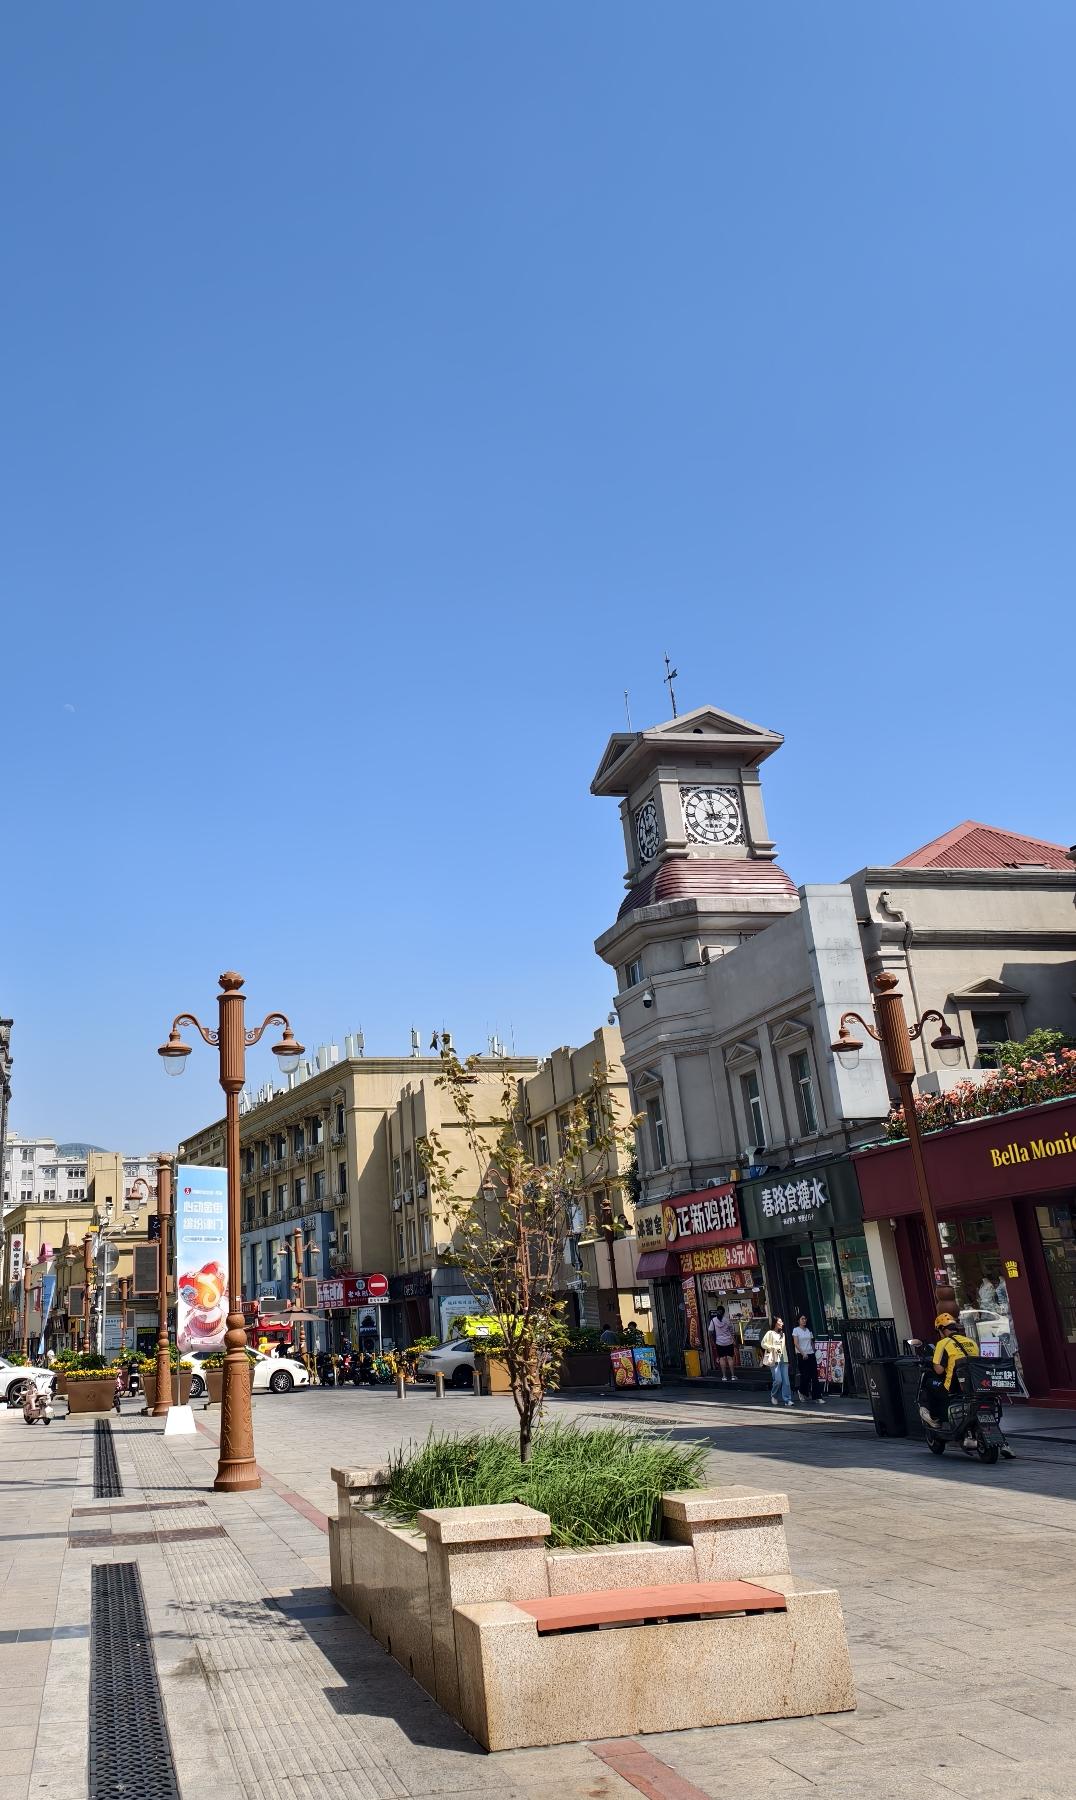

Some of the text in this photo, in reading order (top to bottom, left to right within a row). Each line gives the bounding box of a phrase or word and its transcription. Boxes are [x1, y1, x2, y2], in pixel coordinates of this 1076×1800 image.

[990, 1142, 1030, 1167] Bella
[676, 1194, 737, 1237] 正新鸡排
